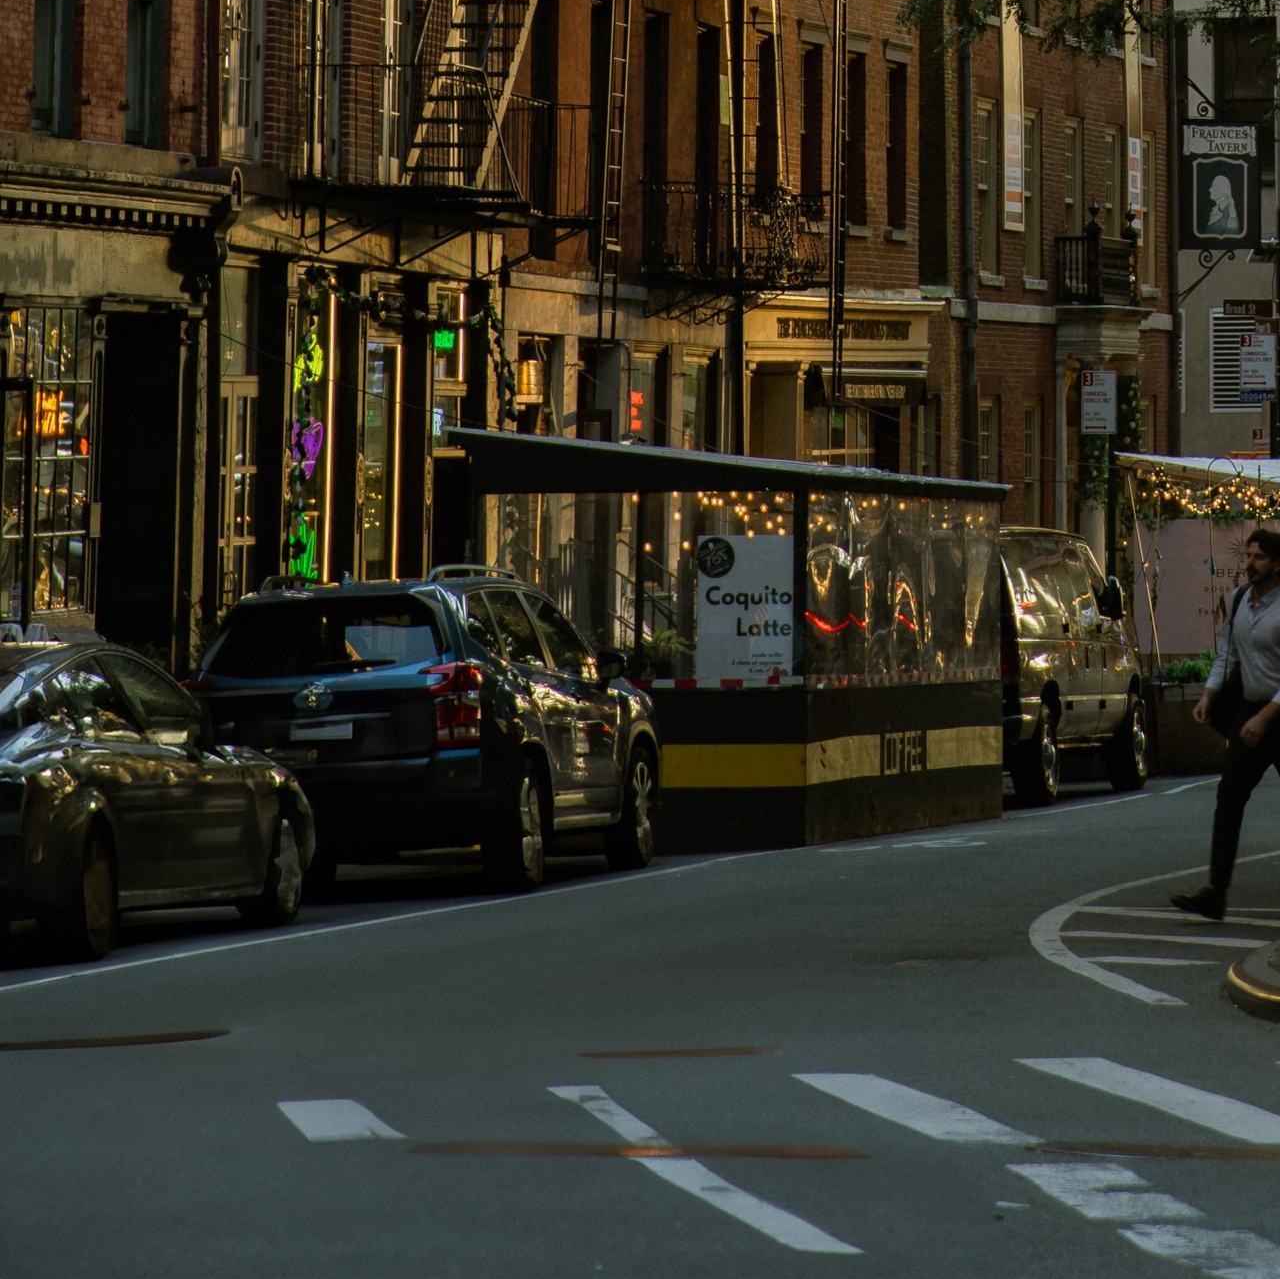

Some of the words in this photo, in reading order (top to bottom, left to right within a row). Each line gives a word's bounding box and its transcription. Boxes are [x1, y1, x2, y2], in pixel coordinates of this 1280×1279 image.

[1191, 127, 1249, 140] FRAUNCES
[1207, 140, 1249, 153] TAVERN
[1225, 303, 1246, 314] Broad
[1248, 304, 1256, 315] St
[1243, 335, 1250, 346] 3
[1084, 373, 1092, 385] 3
[705, 585, 793, 611] Coquito
[736, 617, 792, 637] Latte
[884, 730, 923, 775] COFFEE
